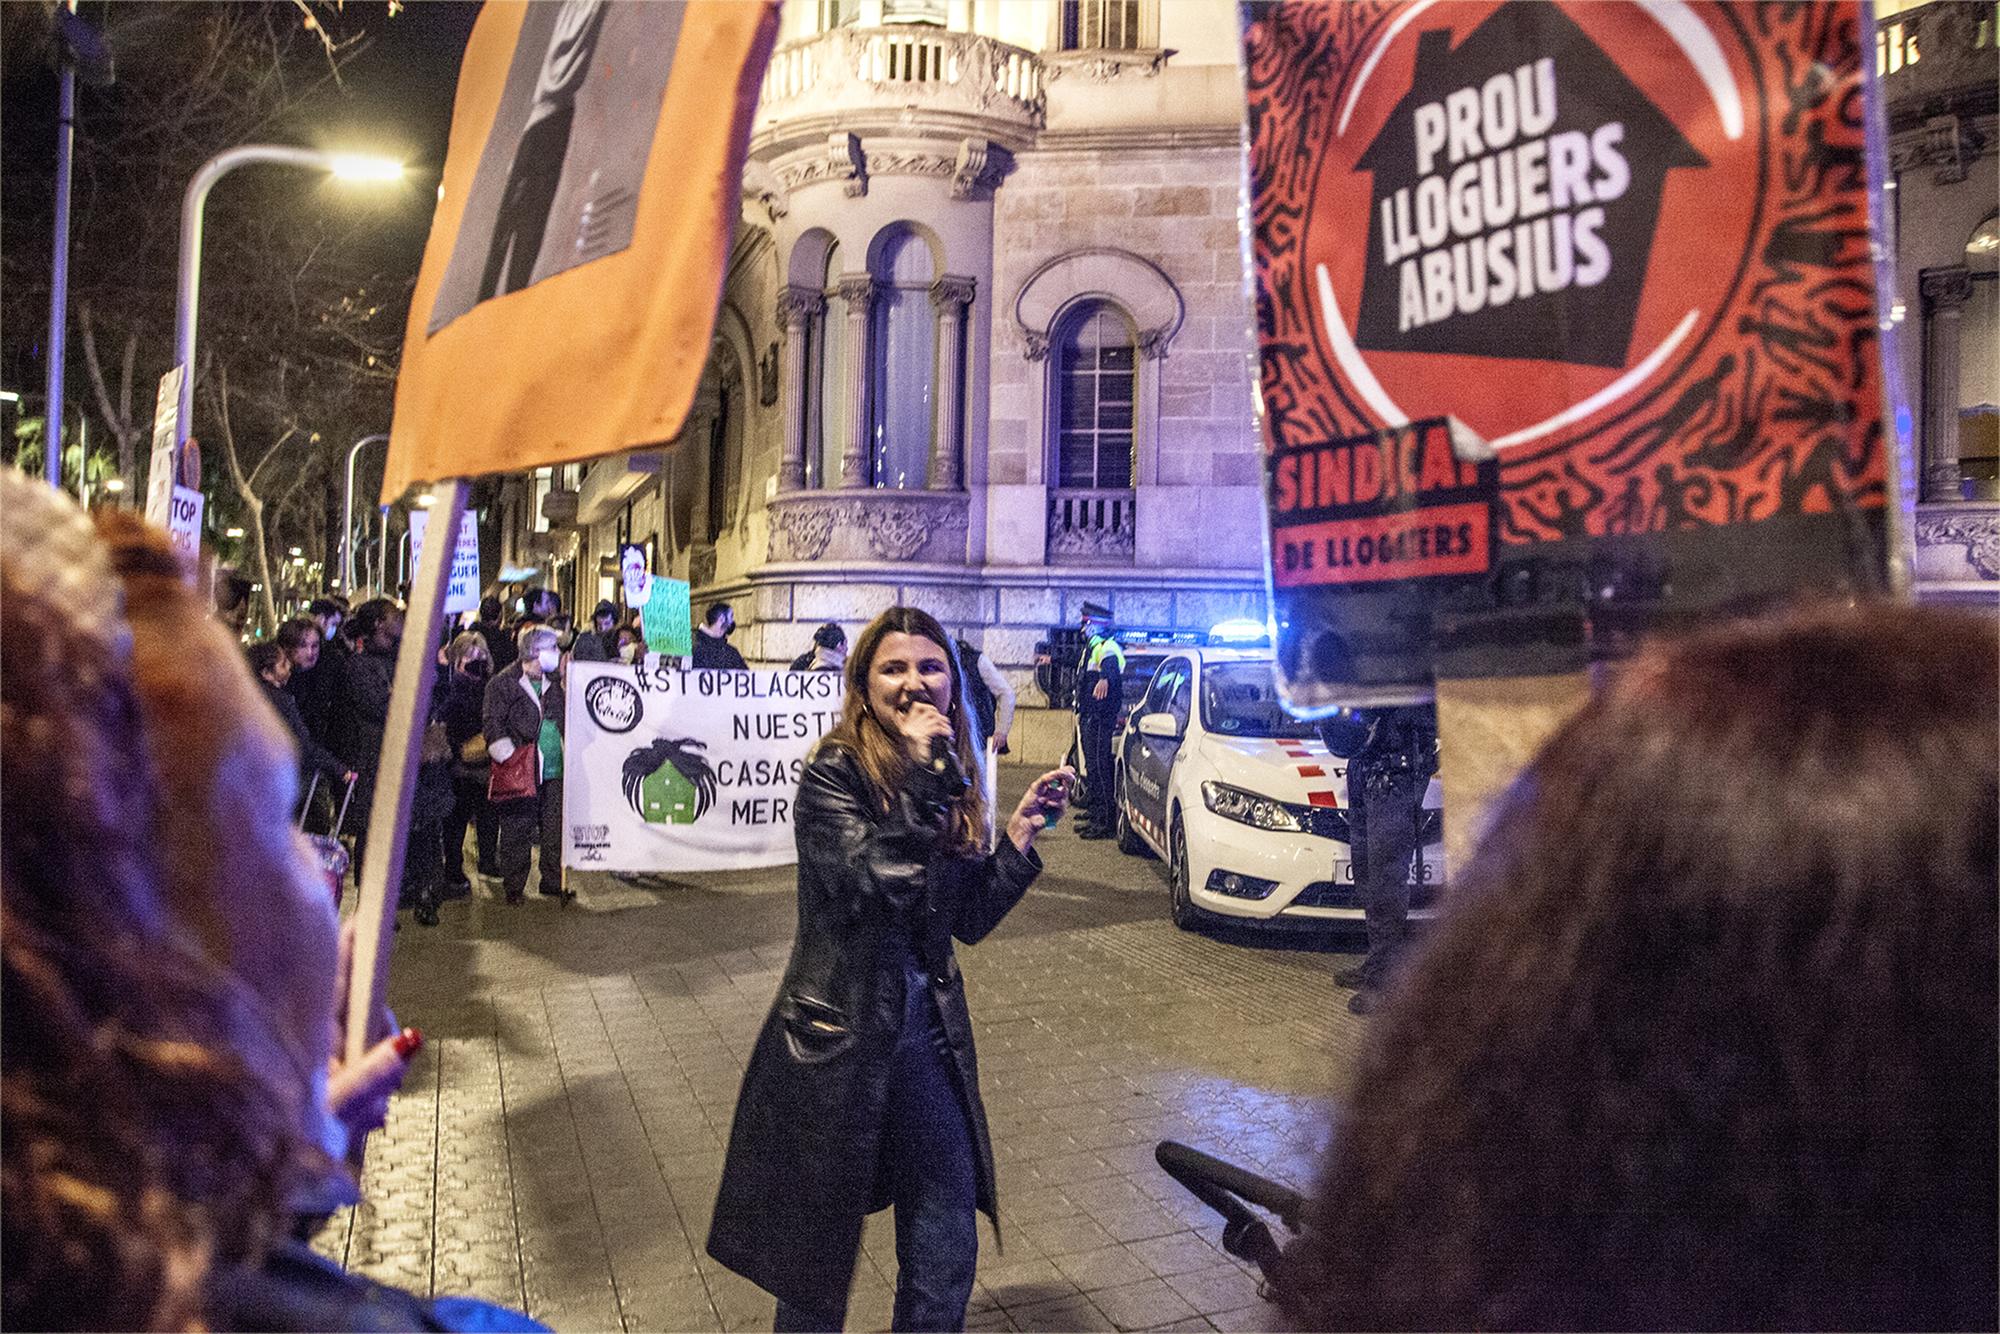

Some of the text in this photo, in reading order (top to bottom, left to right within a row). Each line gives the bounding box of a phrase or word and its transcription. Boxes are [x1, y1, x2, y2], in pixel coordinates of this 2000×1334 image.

[1413, 57, 1557, 174] PROU
[1381, 121, 1631, 265] LLOGUERS
[1400, 207, 1612, 332] ABUSIUS
[172, 498, 196, 522] TOP
[1284, 540, 1314, 571] DE
[635, 663, 843, 700] #STOPBLACKST
[718, 760, 801, 787] CASAS
[732, 799, 788, 825] MER
